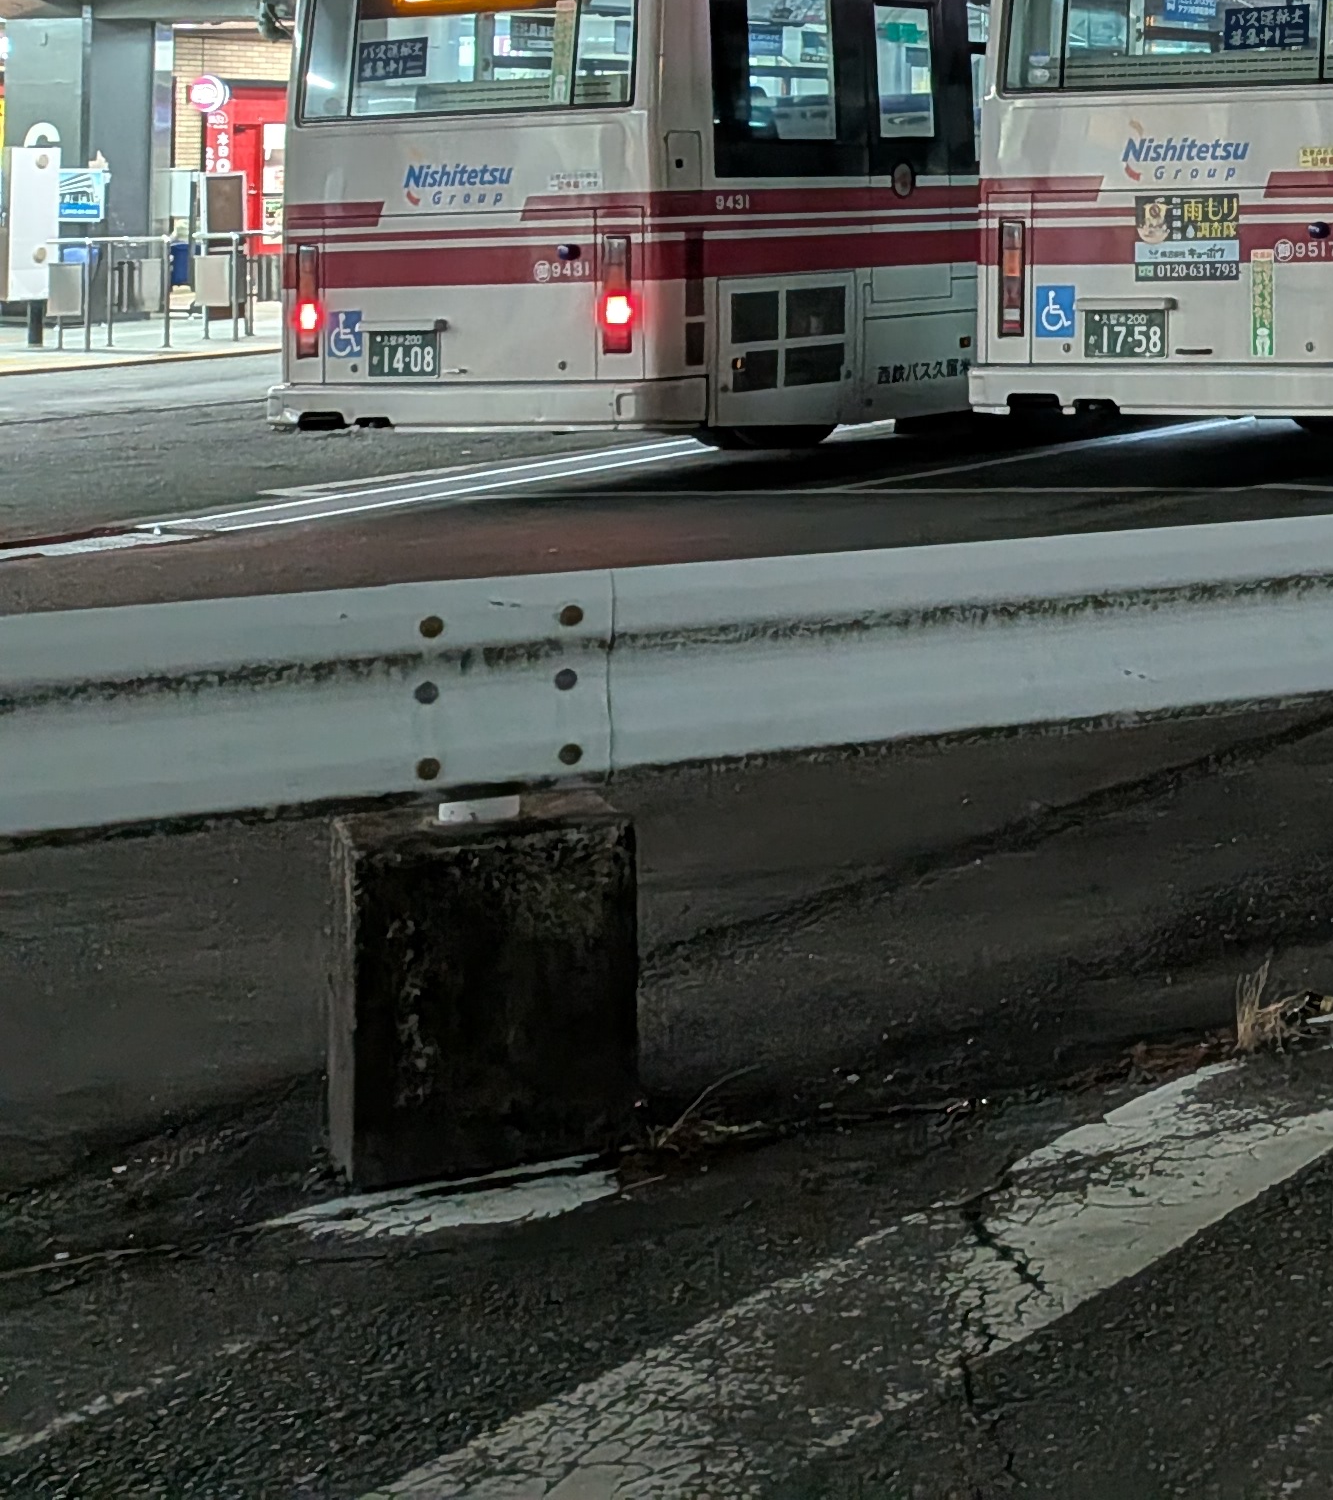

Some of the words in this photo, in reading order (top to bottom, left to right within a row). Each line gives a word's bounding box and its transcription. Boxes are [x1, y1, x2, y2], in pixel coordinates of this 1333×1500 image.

[1122, 137, 1250, 162] Nishitetsu
[403, 163, 514, 189] Nishitetsu
[1153, 164, 1237, 181] Group
[432, 190, 504, 206] Group
[715, 195, 750, 210] 9431
[1183, 197, 1238, 221] 雨もり
[551, 261, 590, 277] 9431
[1157, 263, 1237, 278] 0120-631-793
